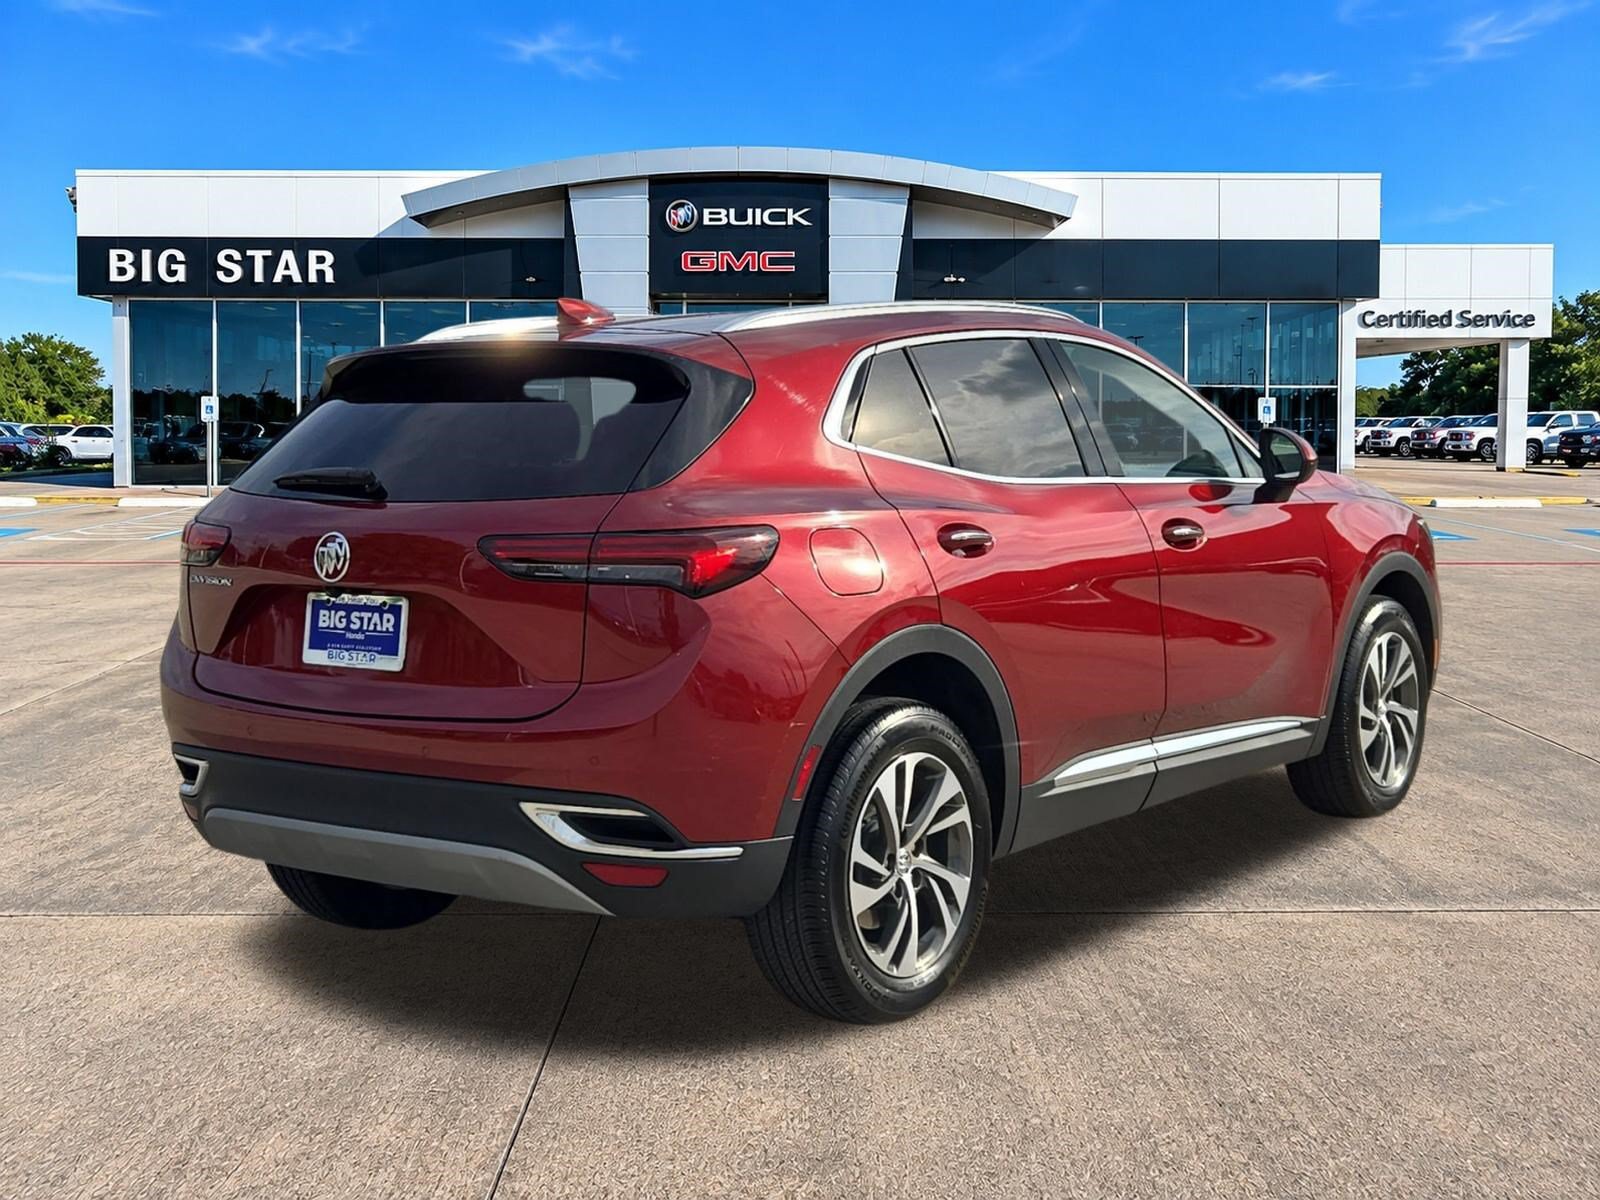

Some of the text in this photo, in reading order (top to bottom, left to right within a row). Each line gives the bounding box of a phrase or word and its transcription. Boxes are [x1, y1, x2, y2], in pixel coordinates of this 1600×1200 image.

[703, 208, 813, 226] BUICK
[108, 248, 336, 284] BIG STAR
[681, 251, 796, 272] GMC
[1359, 309, 1536, 329] Certified Service
[318, 609, 395, 632] BIG STAR
[327, 650, 377, 663] BIG STAR
